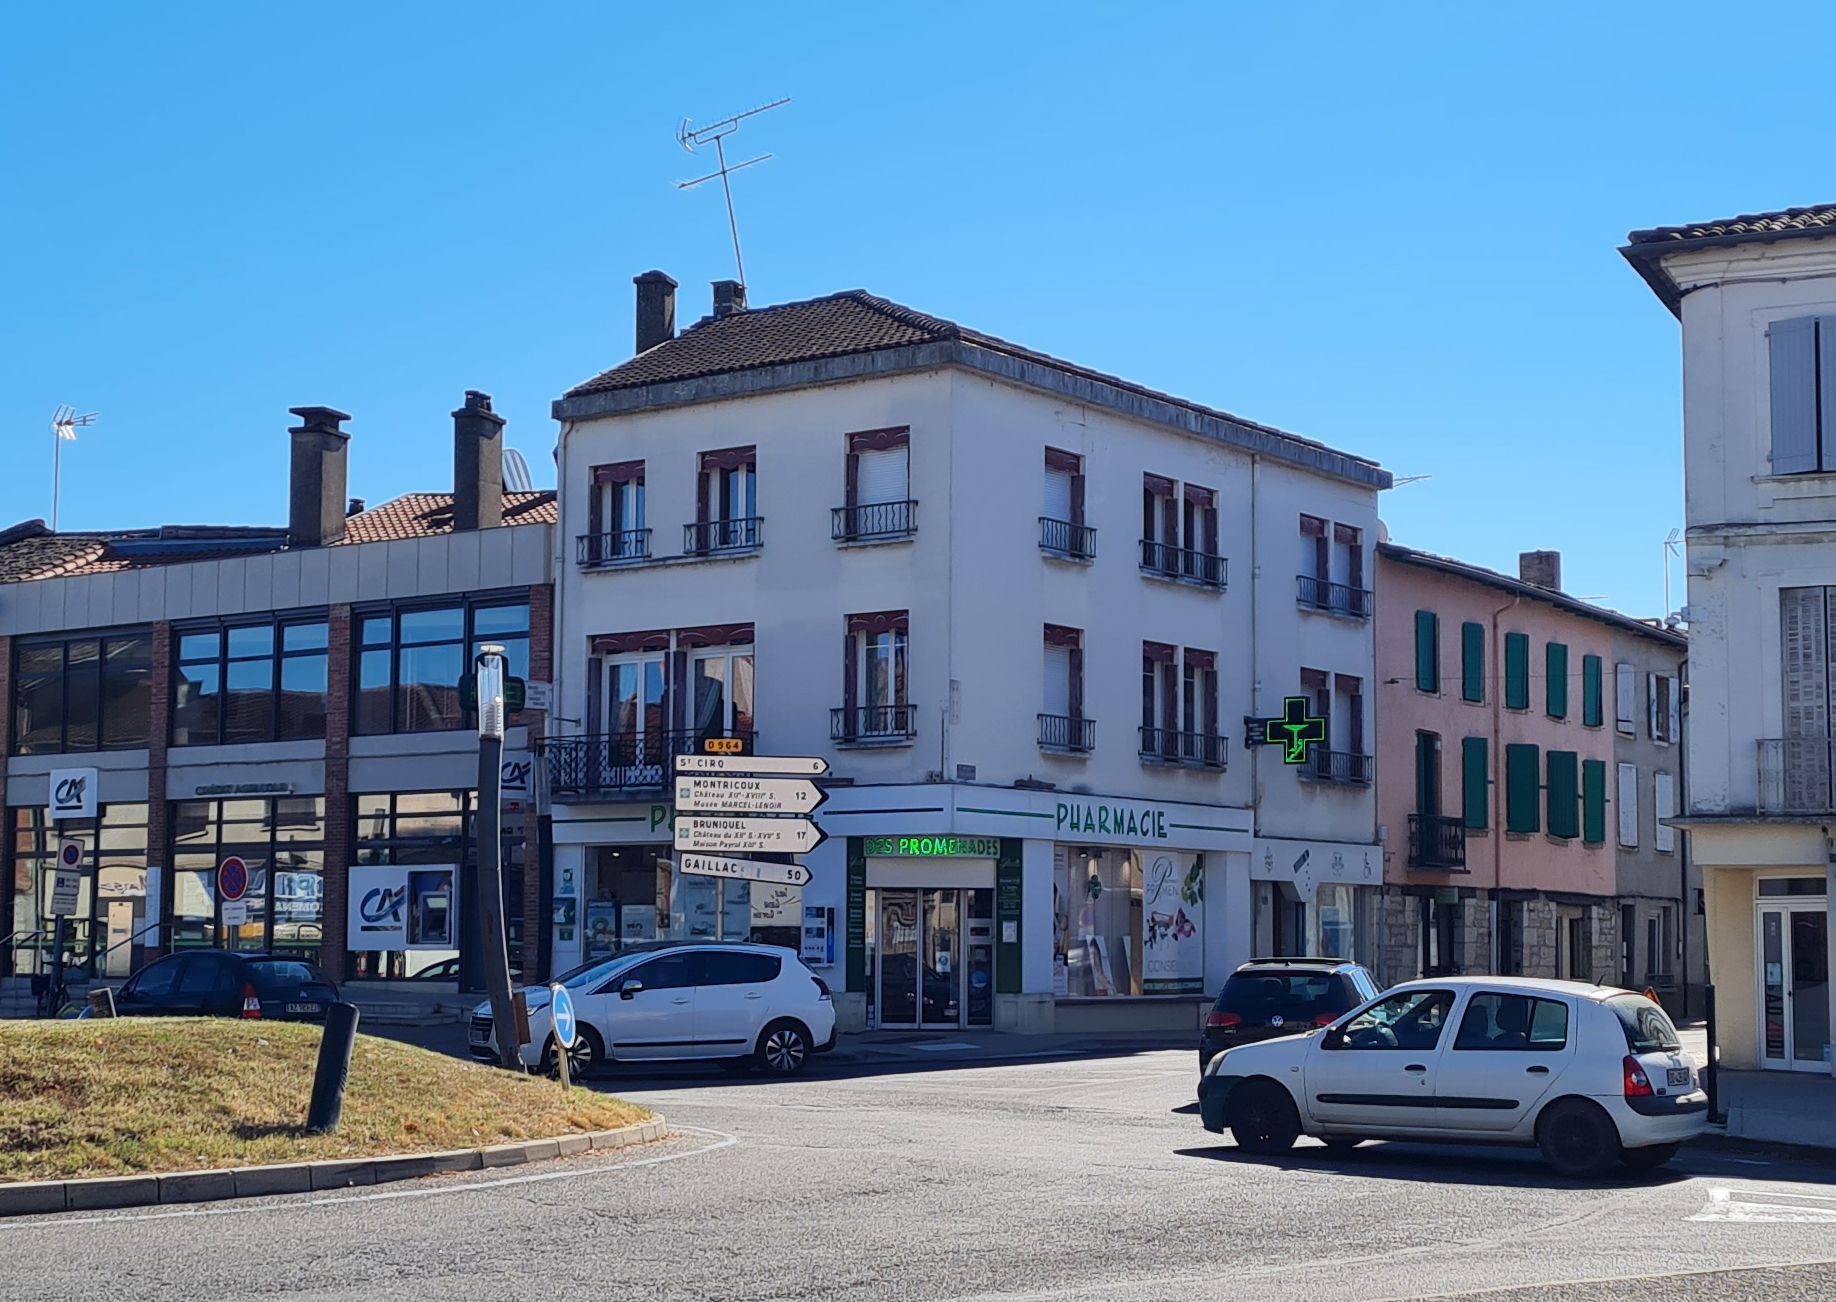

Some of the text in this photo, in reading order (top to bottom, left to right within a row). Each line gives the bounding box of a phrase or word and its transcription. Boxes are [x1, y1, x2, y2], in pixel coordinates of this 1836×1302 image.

[708, 741, 739, 750] D 964
[697, 760, 724, 768] CIRQ
[813, 762, 819, 770] 6
[693, 780, 761, 790] MONTRICOUX
[694, 791, 725, 799] Château
[795, 792, 807, 800] 12
[693, 820, 747, 829] BRUNIQUEL
[1056, 802, 1168, 838] PHARMACIE
[693, 830, 722, 838] Château
[796, 831, 806, 840] 17
[692, 840, 718, 848] Maison
[866, 837, 998, 856] DES PROMENADES
[684, 858, 738, 873] GAILLAC
[787, 869, 801, 880] 50
